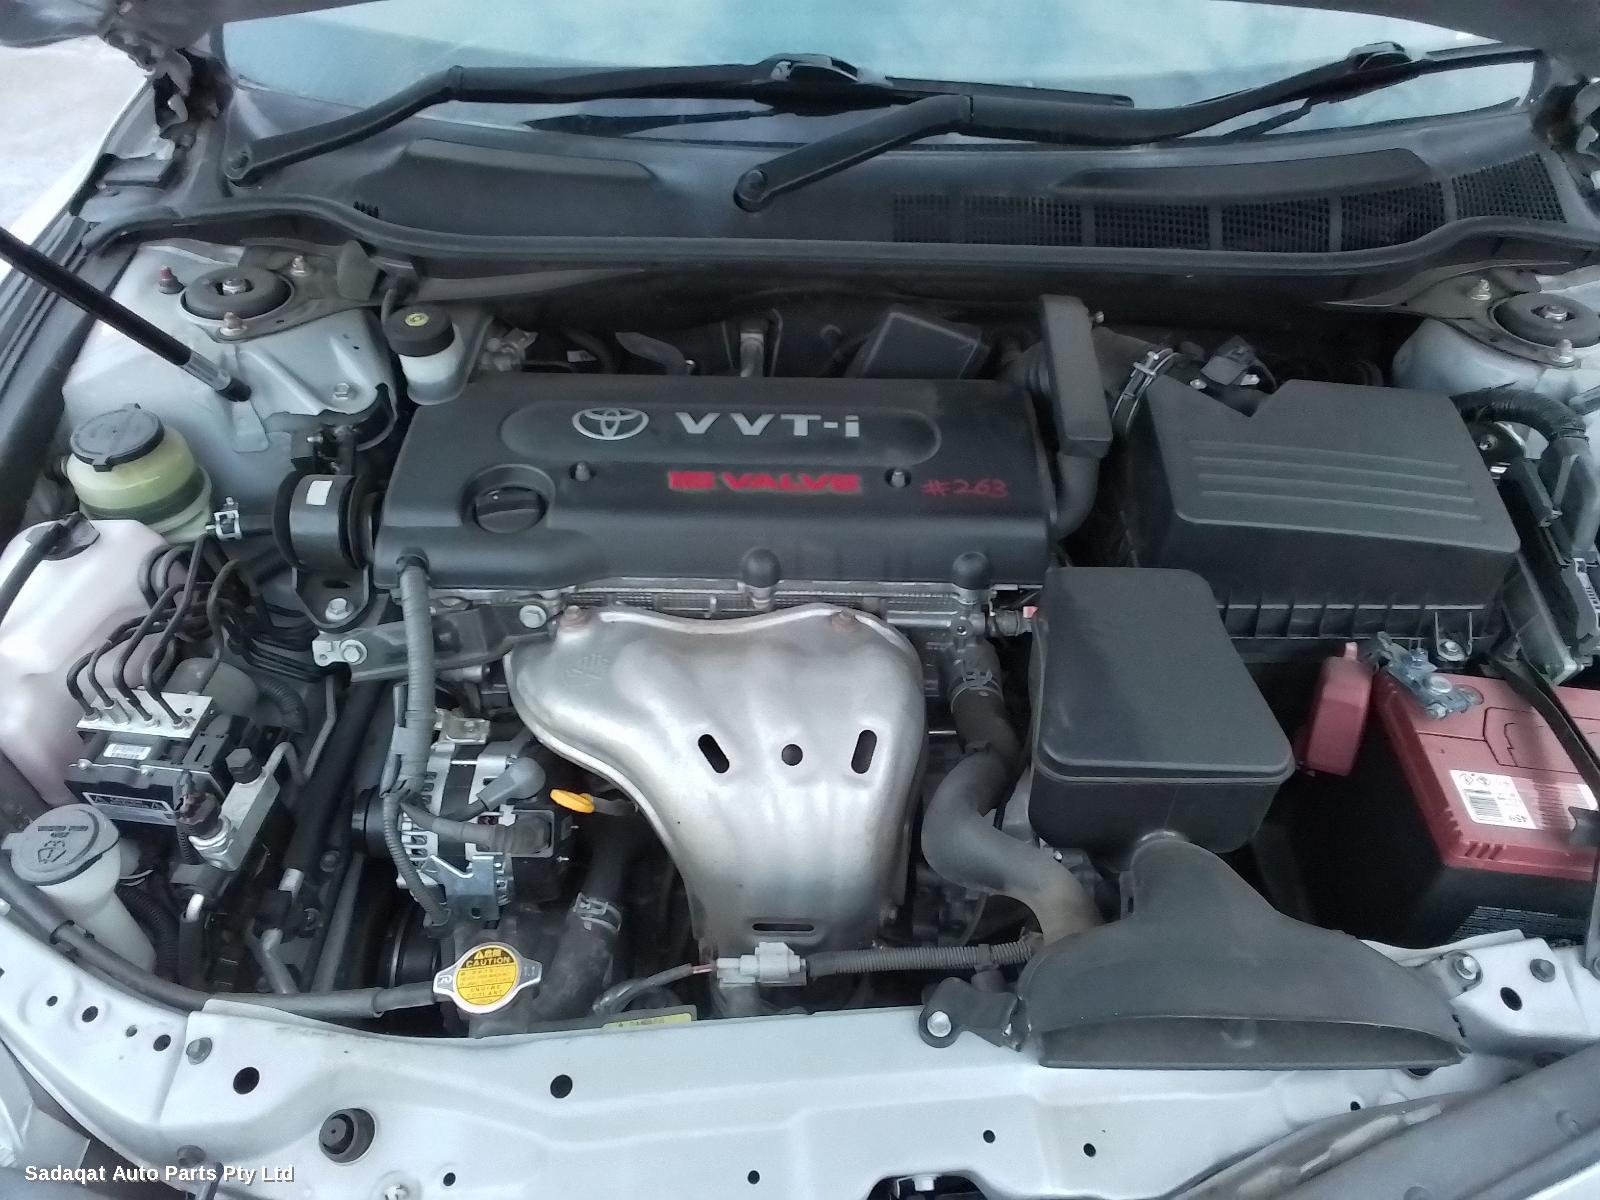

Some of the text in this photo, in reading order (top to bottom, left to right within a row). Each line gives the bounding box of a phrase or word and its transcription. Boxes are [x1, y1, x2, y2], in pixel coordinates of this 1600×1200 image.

[721, 472, 861, 494] VALVE
[920, 479, 1008, 498] #263
[465, 956, 511, 969] CAUTION
